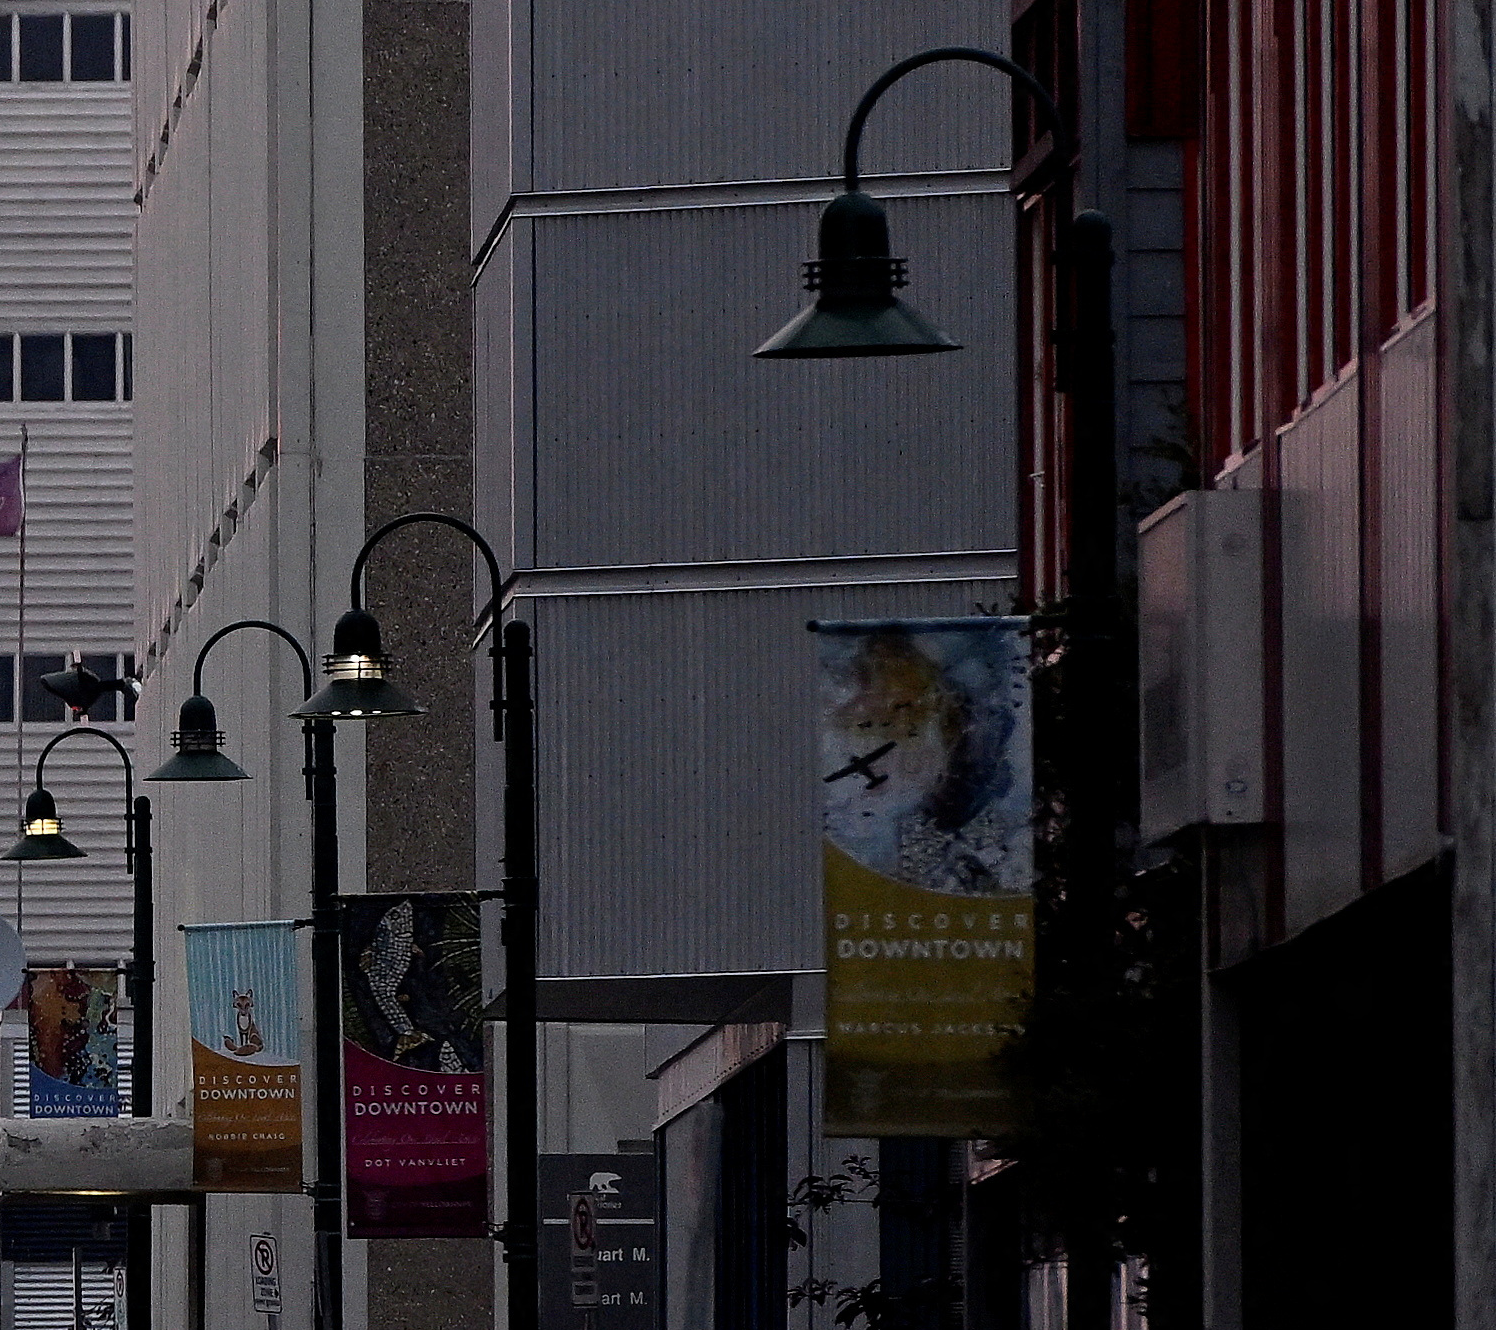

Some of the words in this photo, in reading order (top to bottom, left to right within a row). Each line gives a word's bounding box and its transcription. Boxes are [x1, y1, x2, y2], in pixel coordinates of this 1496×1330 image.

[834, 914, 1029, 930] DISCOVER
[837, 939, 1025, 959] DOWNTOWN
[198, 1074, 297, 1085] DISCOVER
[200, 1088, 295, 1100] DOWNTOWN
[353, 1084, 480, 1096] DISCOVER
[34, 1094, 116, 1102] DISCOVER
[35, 1104, 114, 1114] DOWNTOWN
[354, 1101, 478, 1115] DOWNTOWN
[364, 1159, 391, 1167] DOT
[399, 1158, 466, 1167] VANVLIET
[633, 1248, 651, 1261] M.
[630, 1291, 648, 1306] M.
